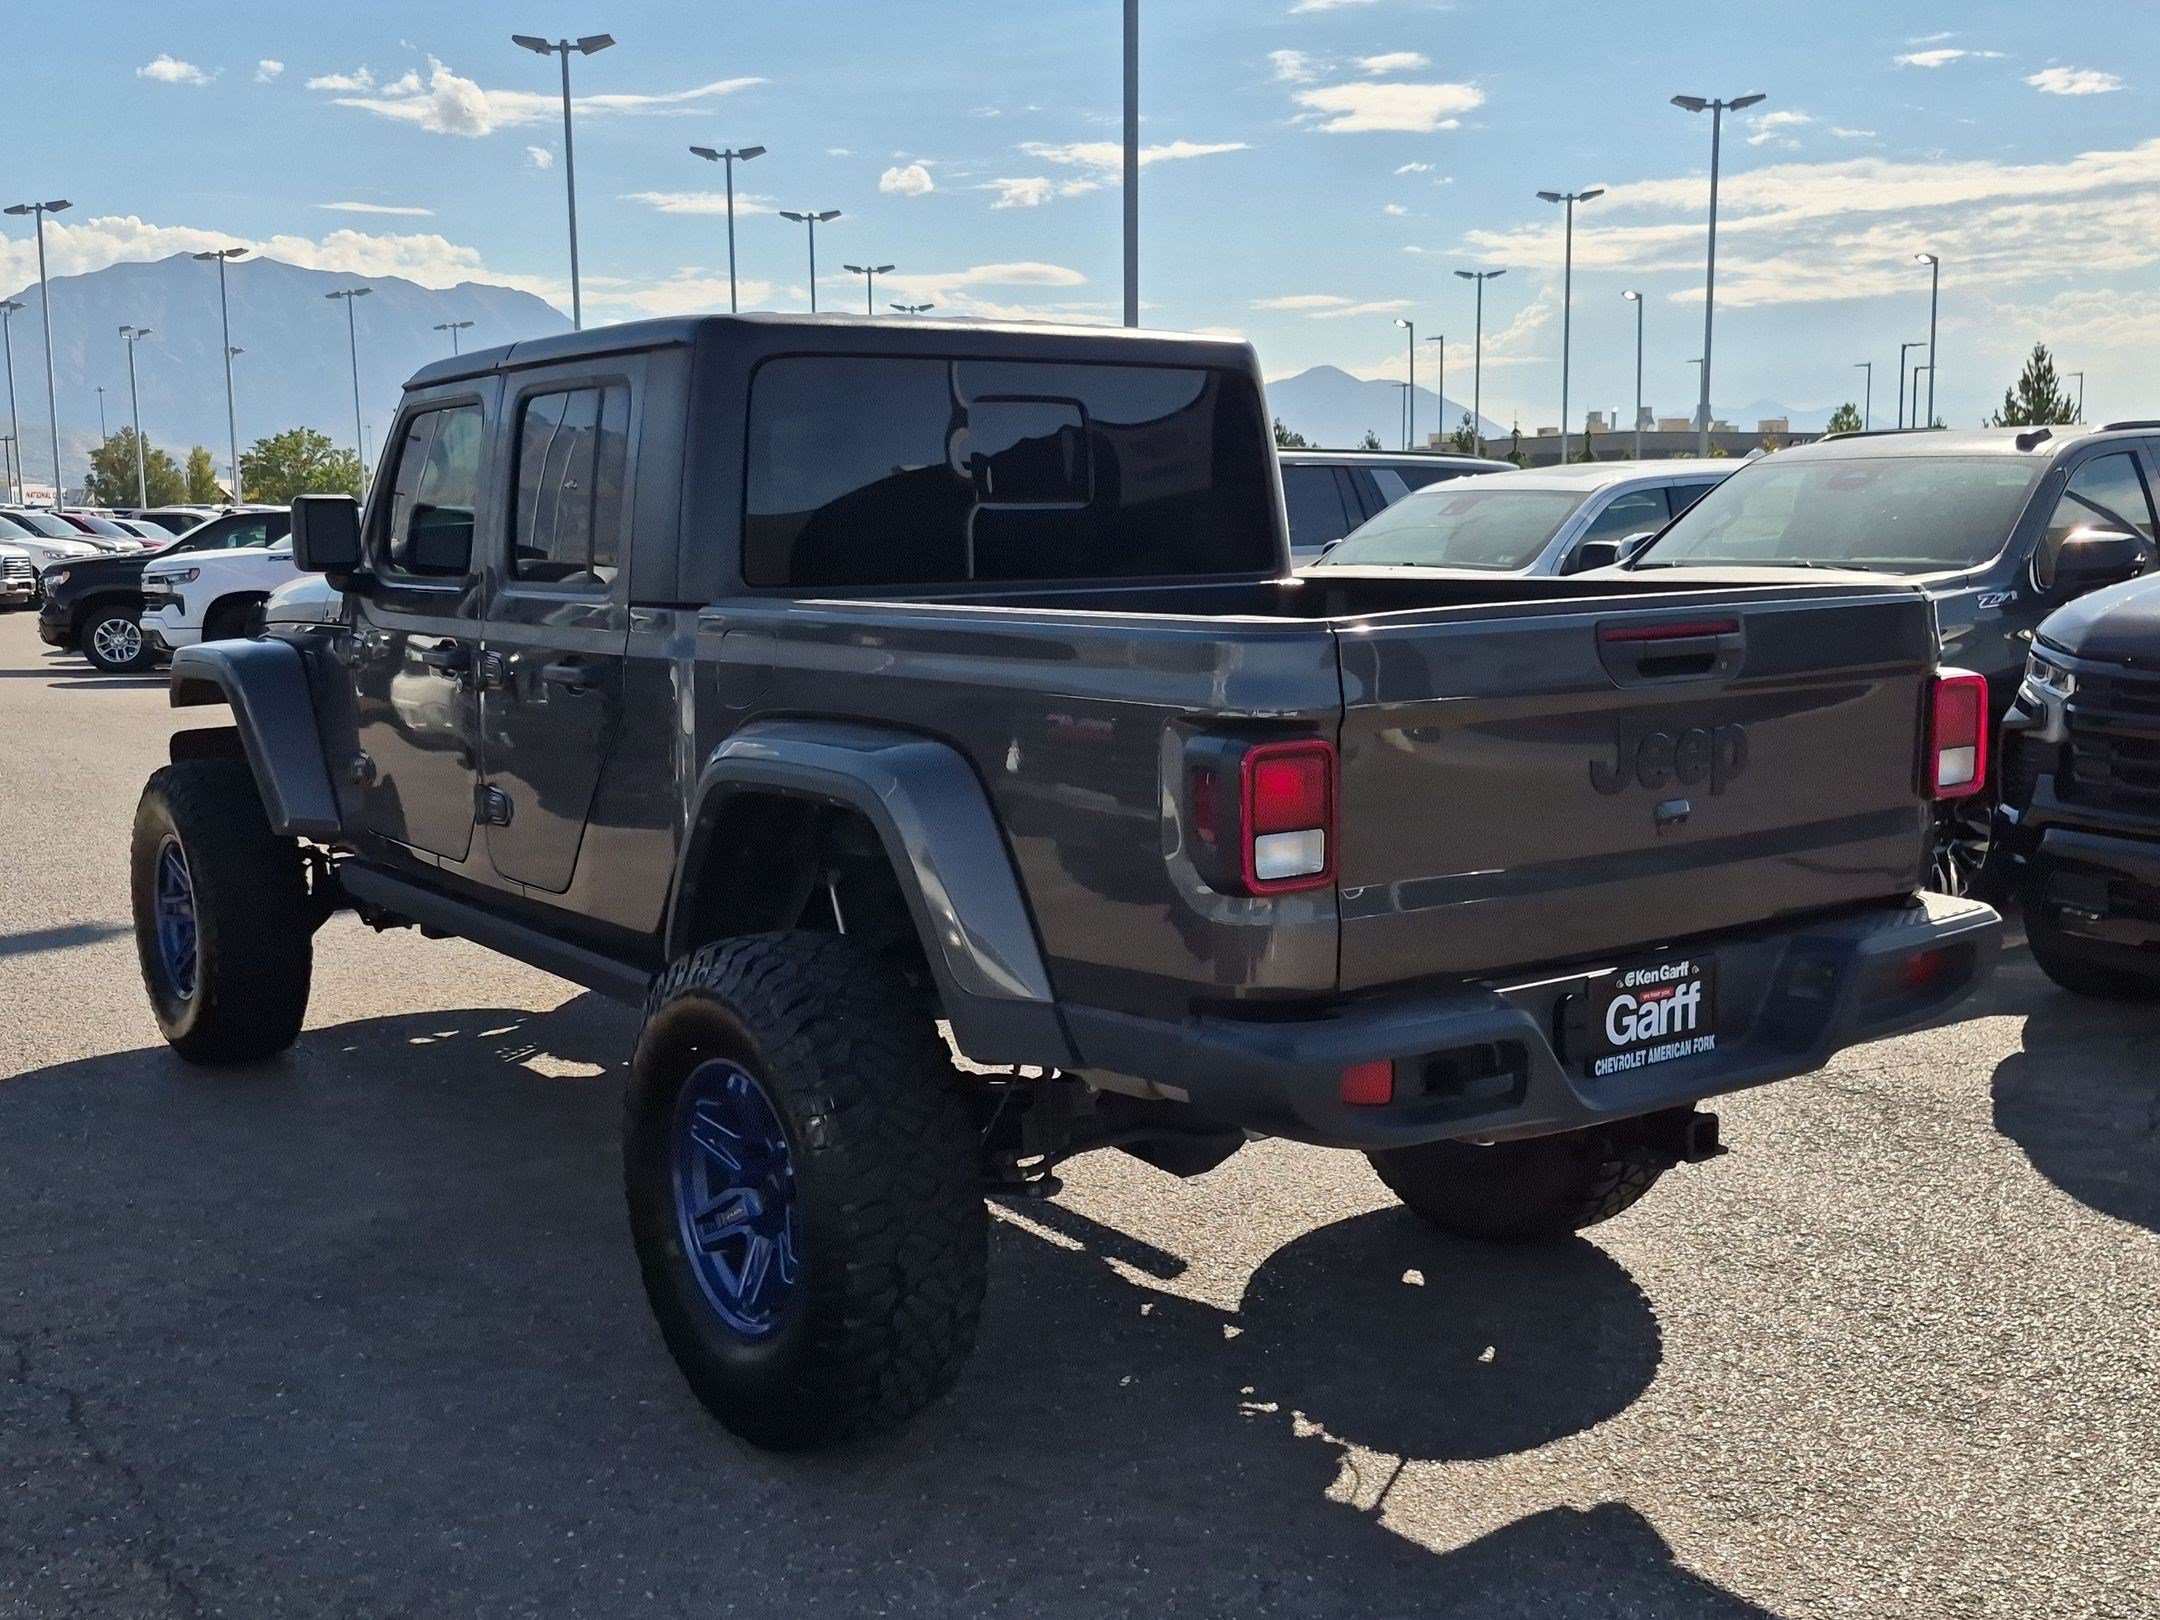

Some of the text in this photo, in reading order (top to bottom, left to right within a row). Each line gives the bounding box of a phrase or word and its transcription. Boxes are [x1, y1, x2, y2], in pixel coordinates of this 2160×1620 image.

[26, 491, 52, 499] NATIONAL
[1976, 590, 2018, 609] Z71
[1589, 716, 1748, 796] Jeep
[1636, 960, 1690, 986] Ken Garff
[1605, 981, 1701, 1046] Garff
[1595, 1034, 1716, 1076] CHEVROLET AMERICAN FORK
